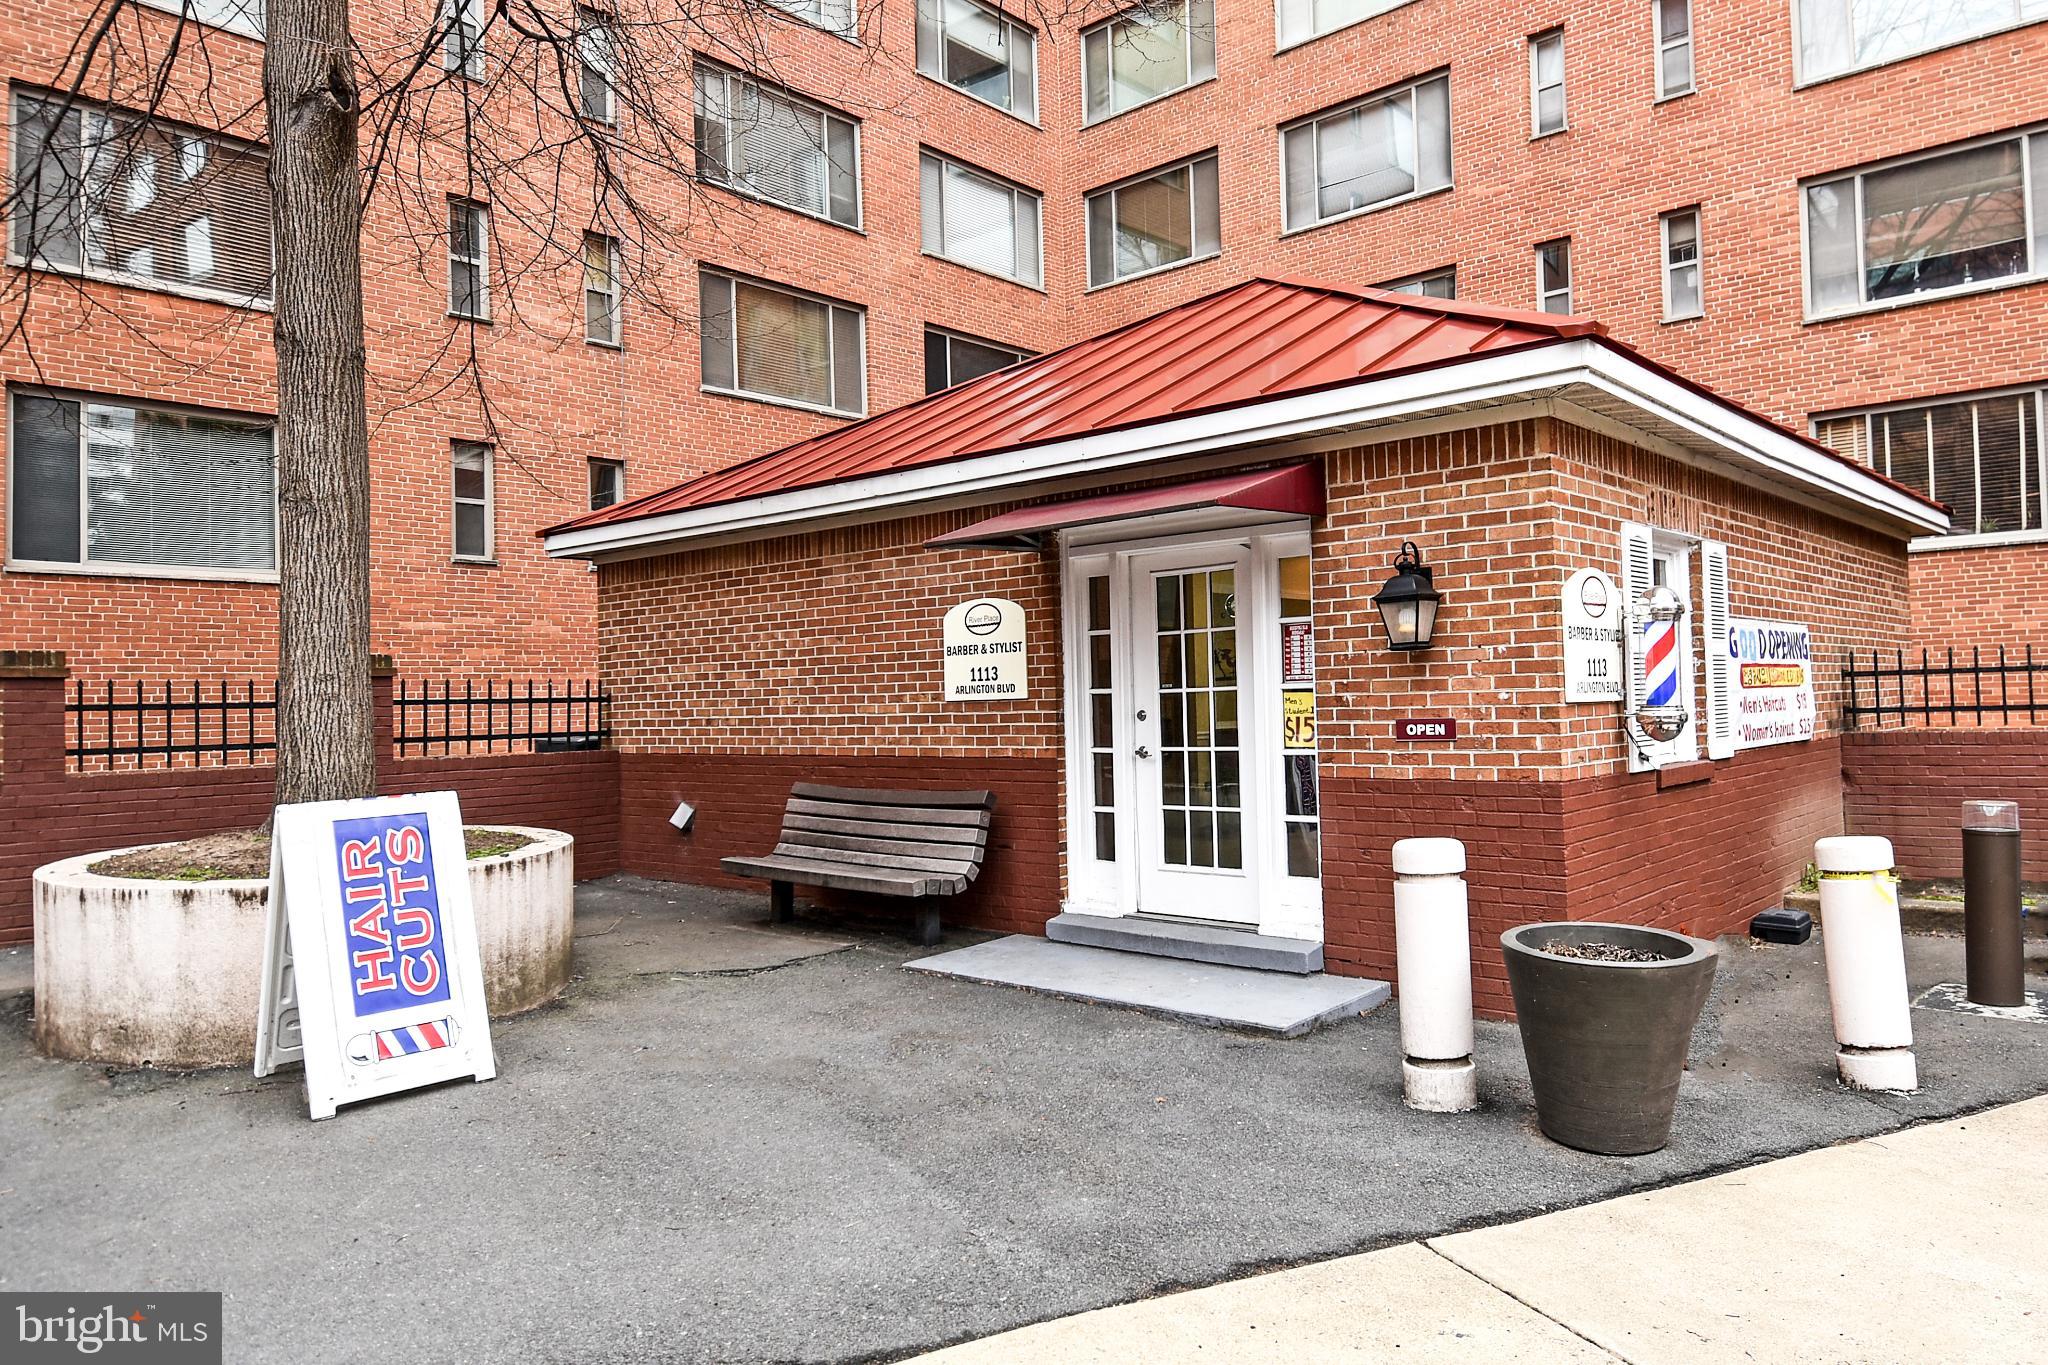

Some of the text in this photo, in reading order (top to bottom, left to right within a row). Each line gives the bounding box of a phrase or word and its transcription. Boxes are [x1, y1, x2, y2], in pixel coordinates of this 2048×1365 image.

[983, 614, 999, 622] Place
[1568, 625, 1593, 641] BARBER
[1595, 628, 1599, 641] &
[946, 641, 1023, 656] BARBER & STYLIST
[1768, 629, 1809, 660] OPENING
[970, 666, 999, 682] 1113
[1587, 658, 1608, 677] 1113
[955, 683, 1016, 694] ARLINGTON BLVD
[1576, 681, 1619, 693] ARLINGTON BLVD
[1285, 717, 1315, 743] $15
[1406, 724, 1446, 736] OPEN
[341, 825, 441, 996] HAIR CUTS
